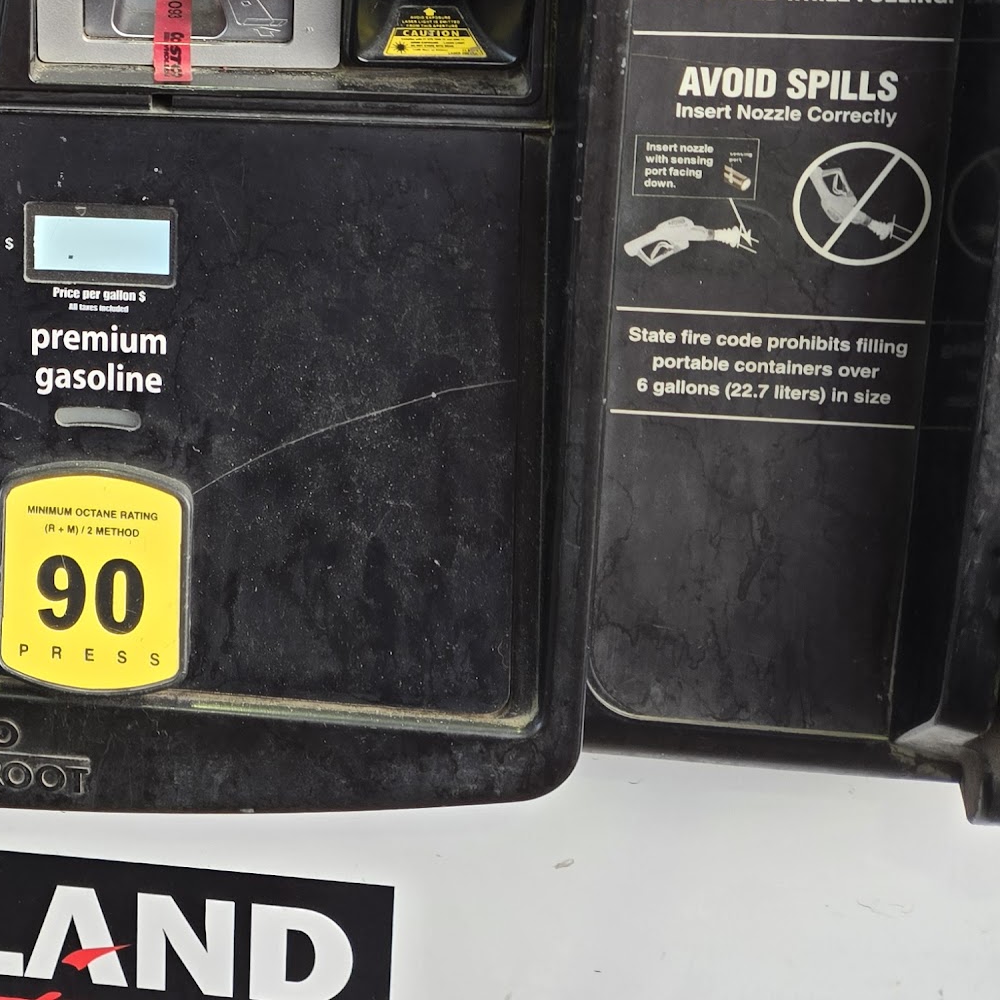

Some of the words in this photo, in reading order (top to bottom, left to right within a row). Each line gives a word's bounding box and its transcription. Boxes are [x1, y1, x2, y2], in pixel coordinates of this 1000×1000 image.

[678, 66, 777, 99] AVOID
[786, 68, 899, 102] SPILLS
[676, 103, 731, 120] Insert
[736, 105, 801, 122] Nozzle
[807, 106, 898, 128] Correctly
[32, 325, 167, 355] premium
[628, 327, 677, 344] State
[681, 329, 711, 347] fire
[716, 331, 762, 349] code
[767, 334, 851, 353] prohibits
[856, 337, 909, 358] filling
[35, 363, 162, 395] gasoline
[652, 354, 729, 373] portable
[734, 359, 834, 378] containers
[838, 364, 880, 380] over
[37, 555, 145, 634] 90
